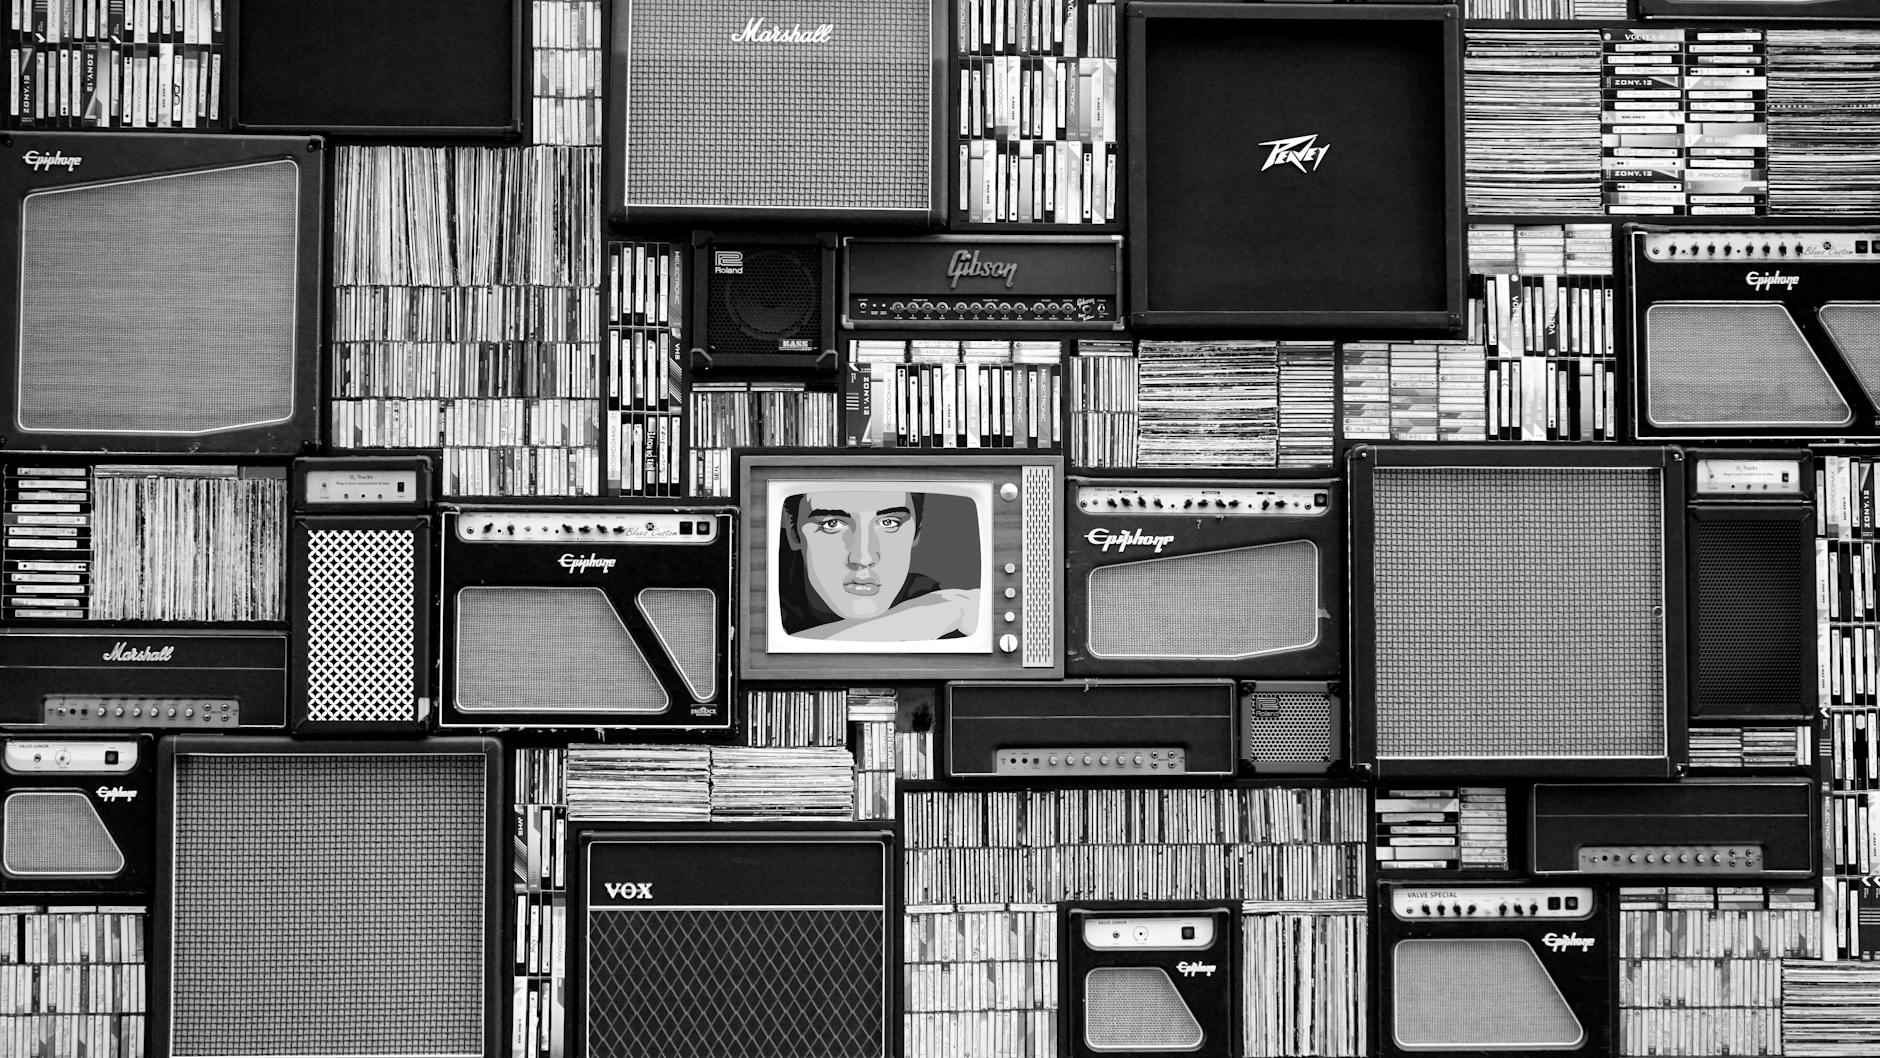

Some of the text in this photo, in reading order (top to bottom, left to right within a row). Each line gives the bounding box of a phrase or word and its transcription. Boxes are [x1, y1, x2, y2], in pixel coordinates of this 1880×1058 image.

[731, 17, 834, 42] Marshall
[21, 150, 82, 171] Epiphone
[1257, 133, 1331, 174] PEAVEY
[715, 266, 744, 274] Roland
[947, 249, 1018, 289] Gibson
[1745, 270, 1800, 292] Epiphone
[1083, 528, 1175, 553] Epiphone
[557, 552, 617, 574] Epiphone
[102, 641, 175, 662] Marshall
[604, 882, 653, 899] VOX
[1541, 931, 1596, 953] Epiphone
